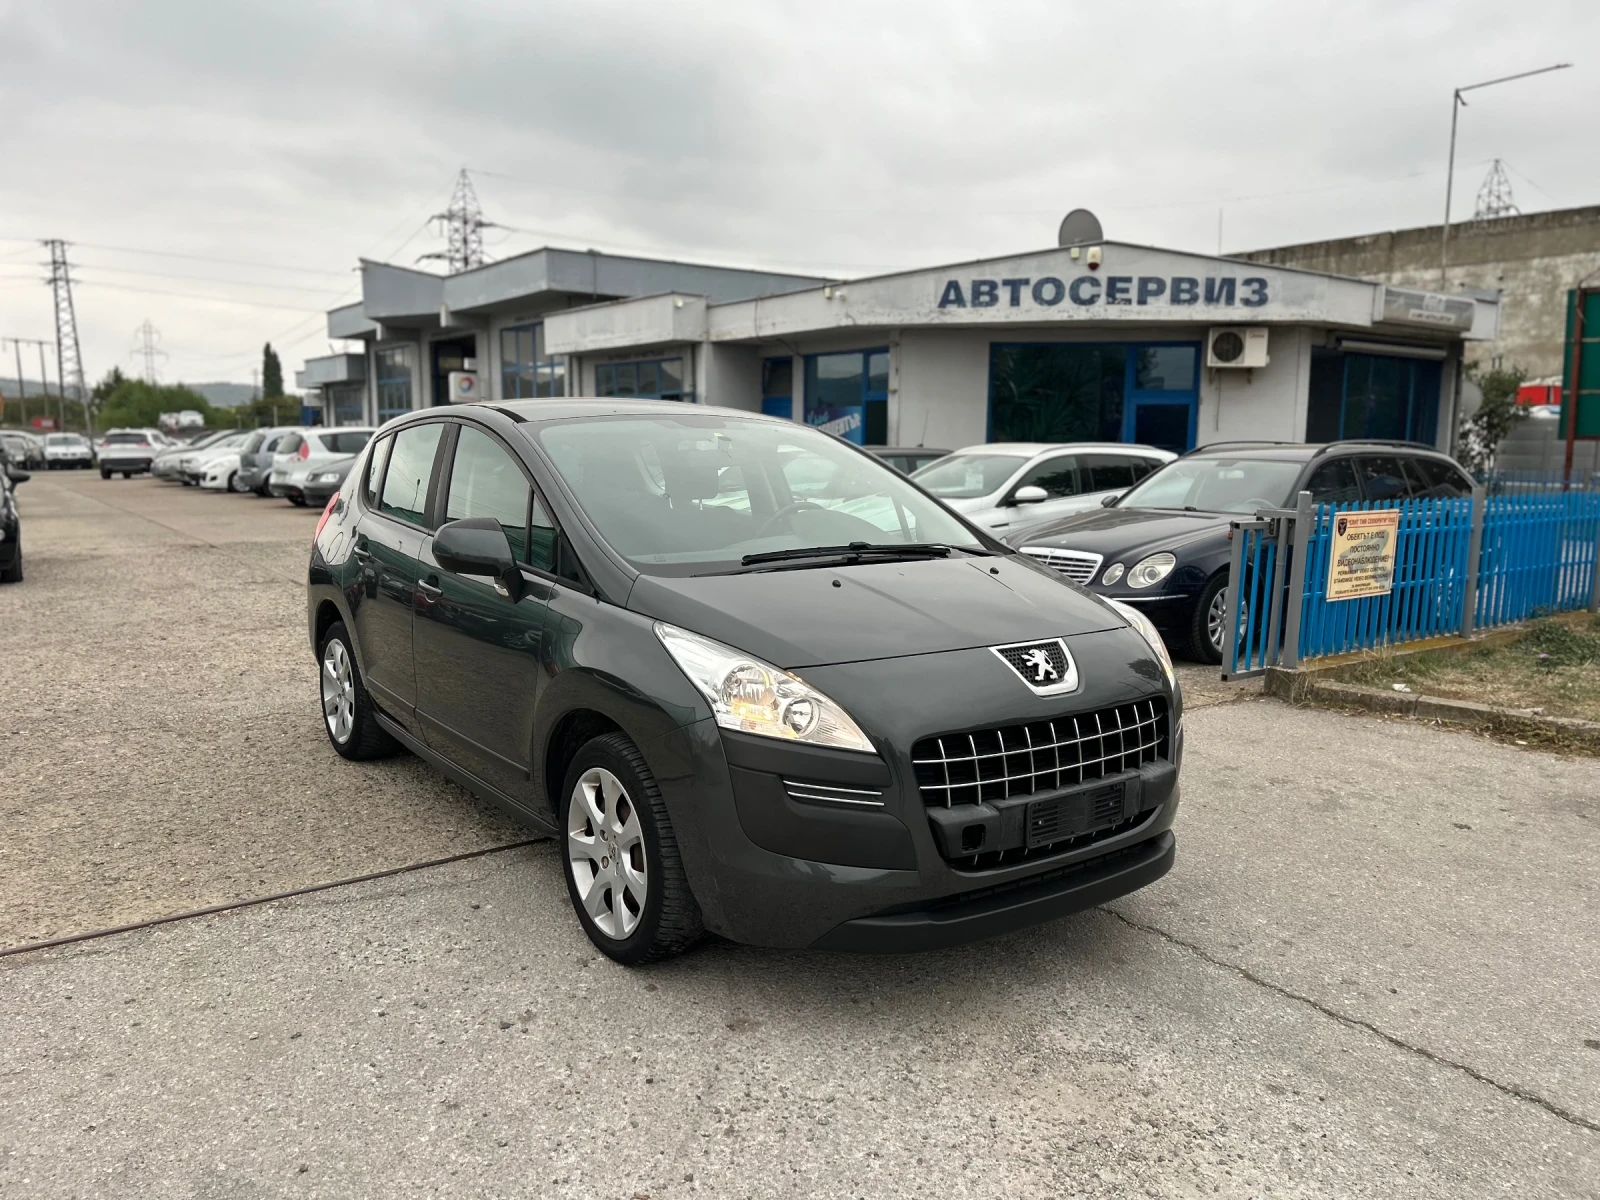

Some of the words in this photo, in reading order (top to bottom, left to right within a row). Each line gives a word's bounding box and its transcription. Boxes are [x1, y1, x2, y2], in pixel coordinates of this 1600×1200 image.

[937, 275, 1270, 309] АВТОСЕРВИЗ
[1347, 532, 1370, 541] ОБЕКТЪТ
[1375, 531, 1385, 539] ПОД
[1350, 544, 1380, 553] ПОСТОЯННО
